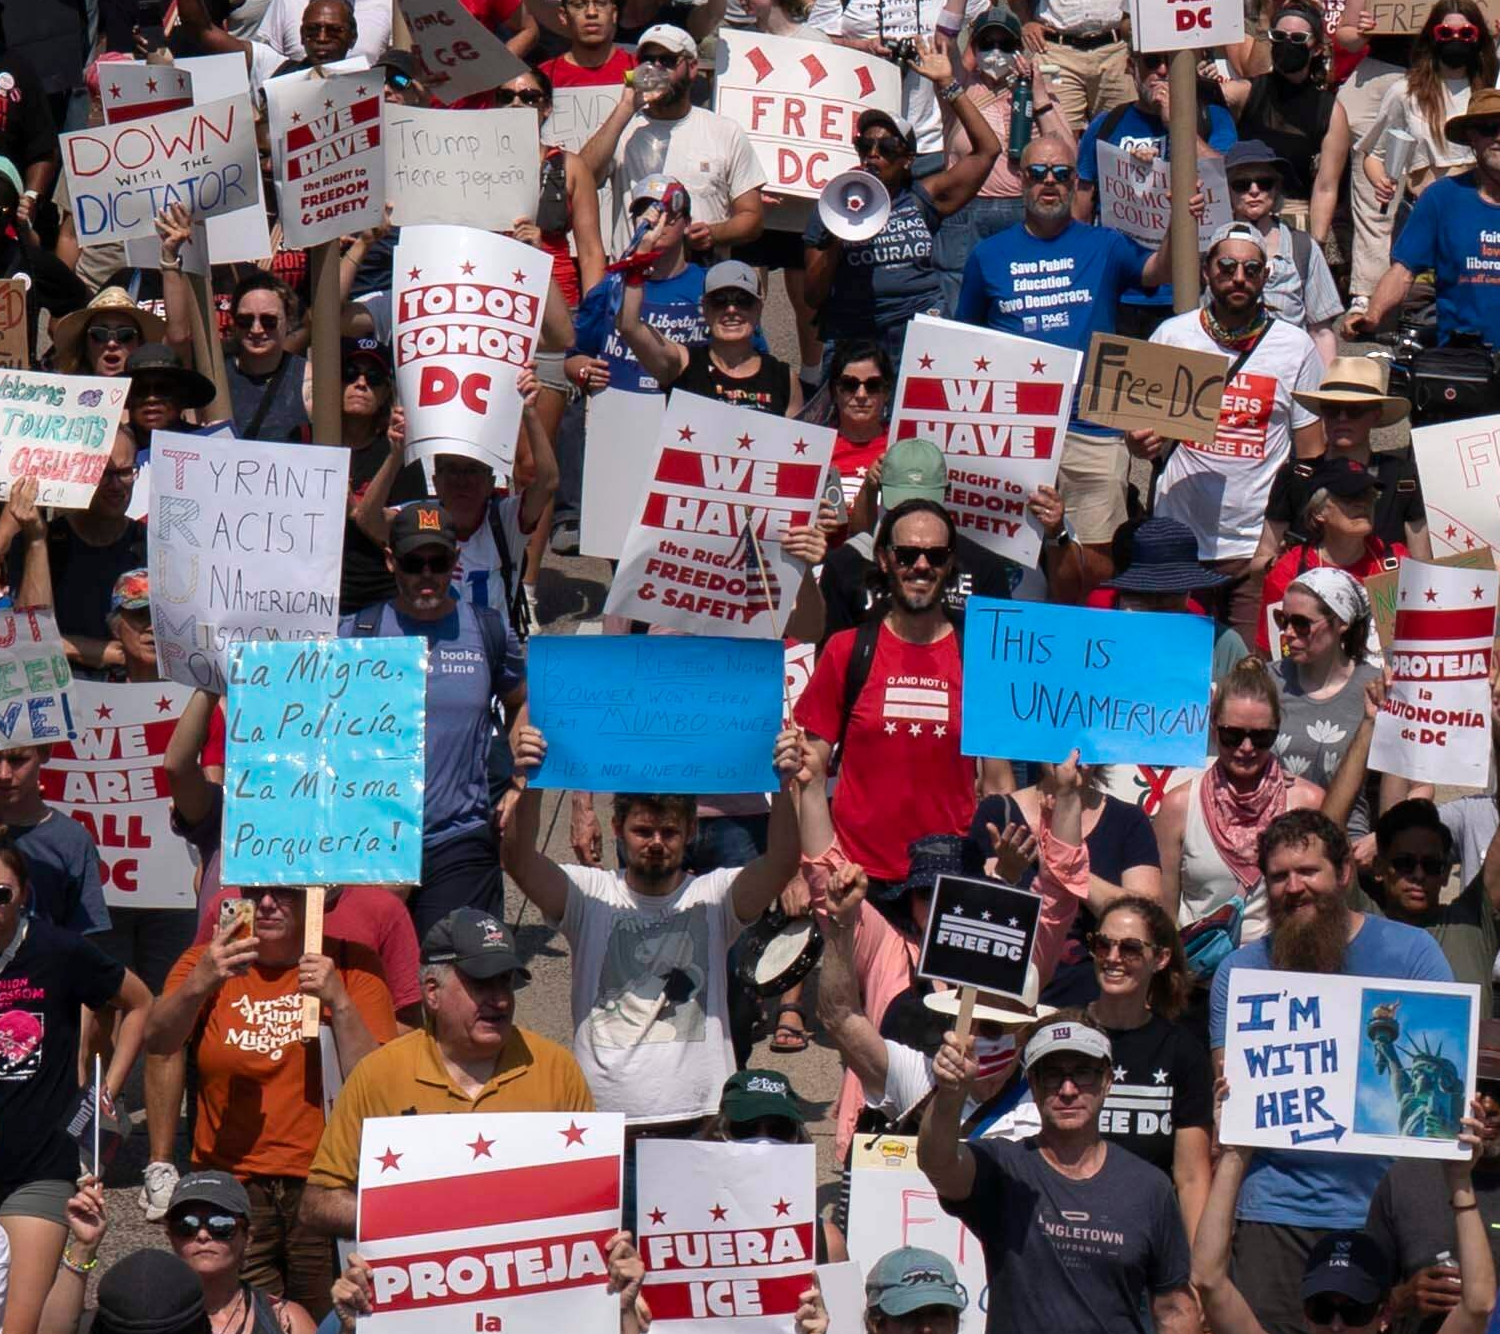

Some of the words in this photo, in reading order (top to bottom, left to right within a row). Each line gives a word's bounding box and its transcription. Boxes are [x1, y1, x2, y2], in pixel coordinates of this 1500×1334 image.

[69, 106, 237, 179] DOWN
[116, 169, 162, 188] WITH
[182, 156, 213, 174] THE
[75, 166, 249, 238] DICTATOR
[1009, 262, 1040, 277] Save
[1042, 258, 1075, 276] Public
[977, 609, 1054, 663] THIS
[1084, 639, 1113, 670] IS
[1011, 682, 1210, 739] UNAMERICAN
[1245, 1042, 1339, 1081] WITH
[1254, 1086, 1327, 1131] HER
